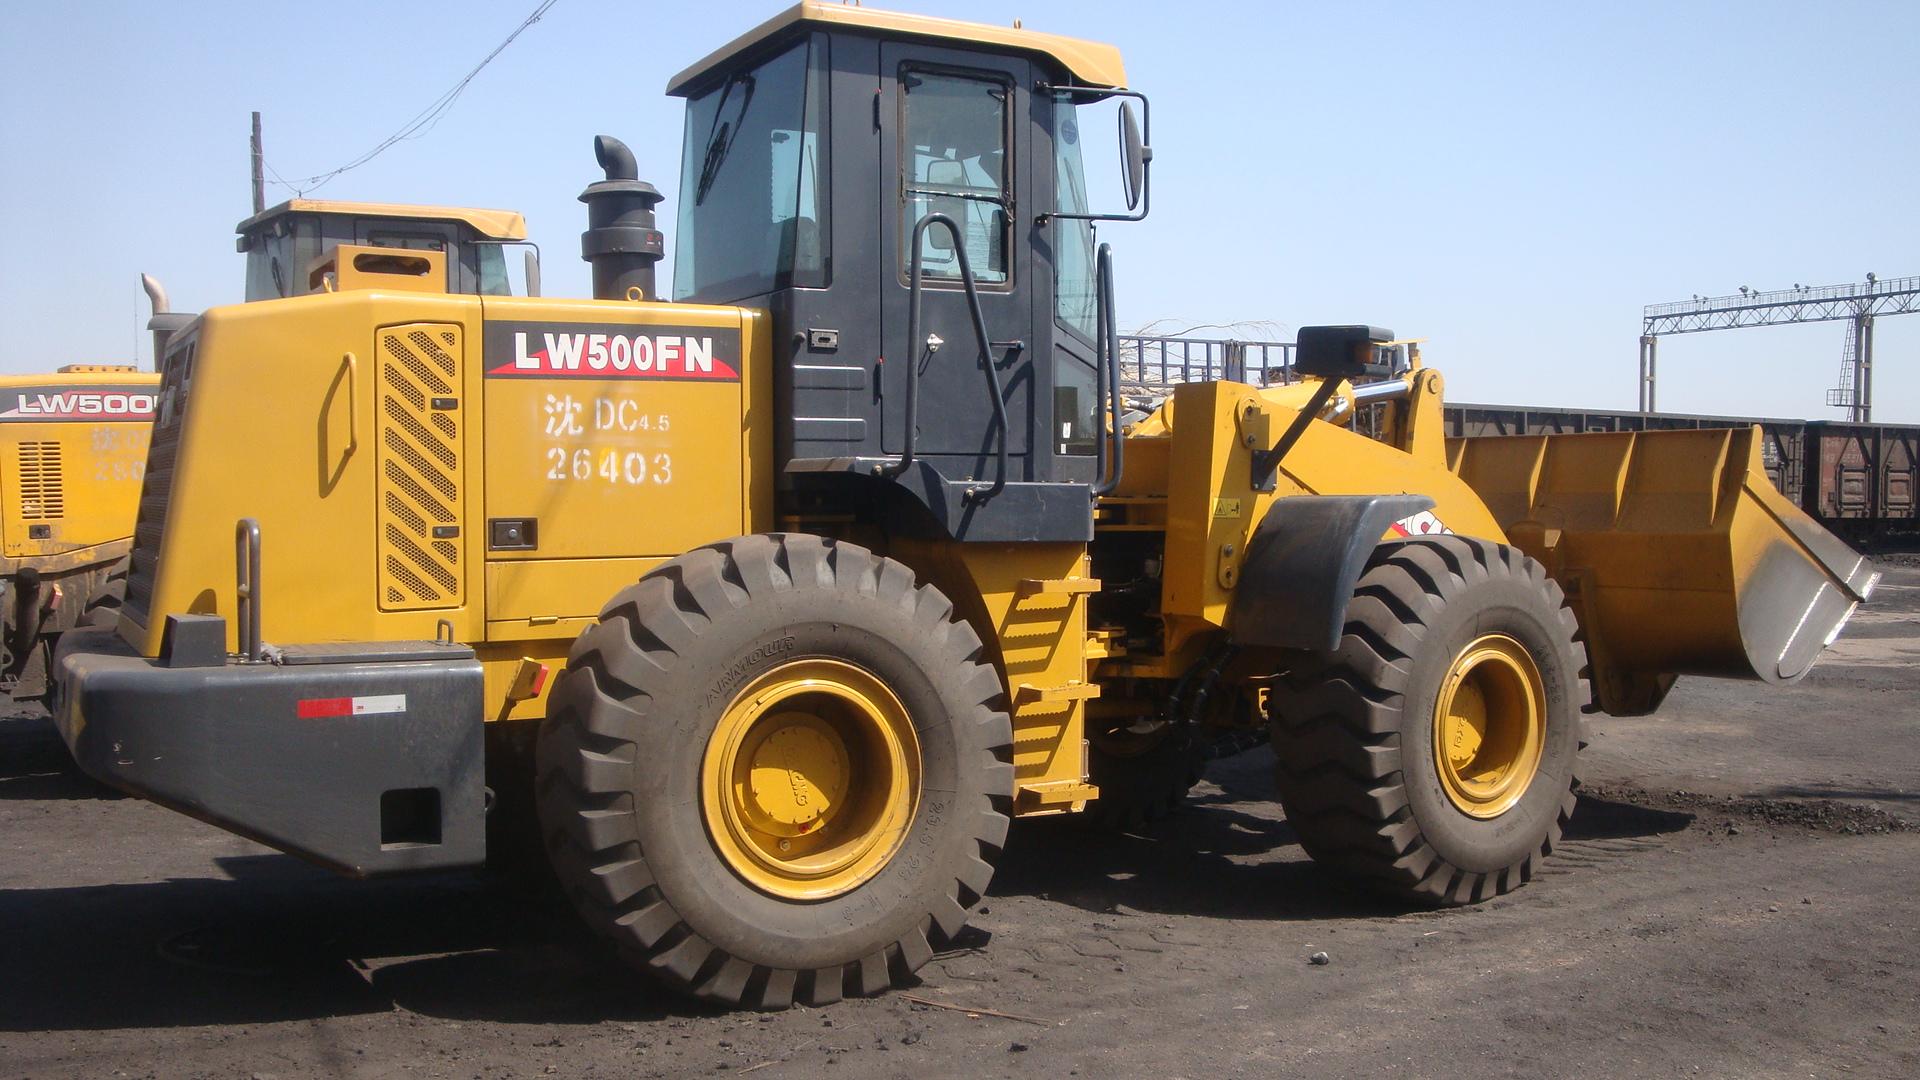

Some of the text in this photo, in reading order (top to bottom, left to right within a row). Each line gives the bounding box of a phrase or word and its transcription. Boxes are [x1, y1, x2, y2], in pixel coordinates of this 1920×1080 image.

[514, 331, 714, 373] LW500FN
[544, 393, 584, 437] 沈
[545, 447, 673, 485] 26403
